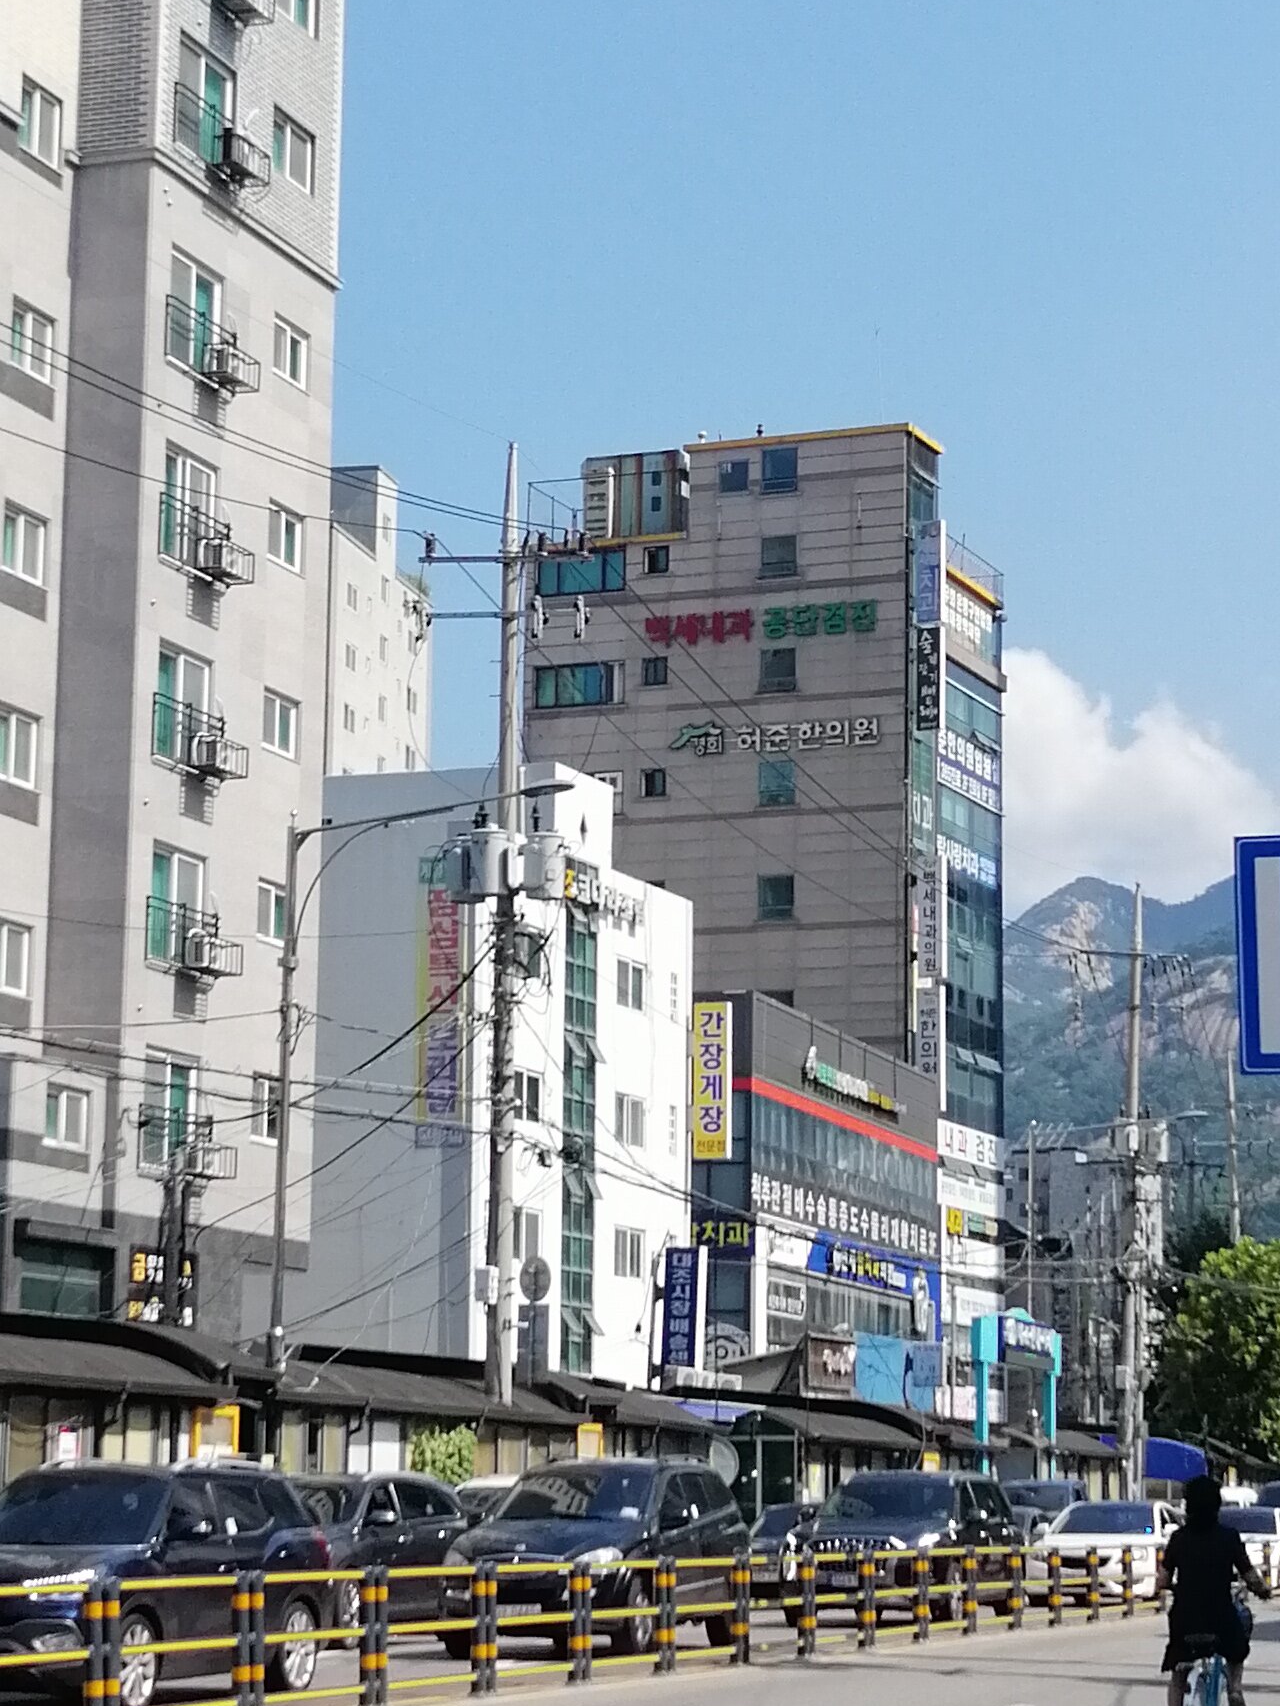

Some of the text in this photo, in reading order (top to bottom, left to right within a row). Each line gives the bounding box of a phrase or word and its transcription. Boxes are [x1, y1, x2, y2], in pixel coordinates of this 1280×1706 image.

[763, 600, 879, 638] 공단검진
[737, 718, 879, 752] 허준한의원
[699, 1011, 725, 1134] 간장게장
